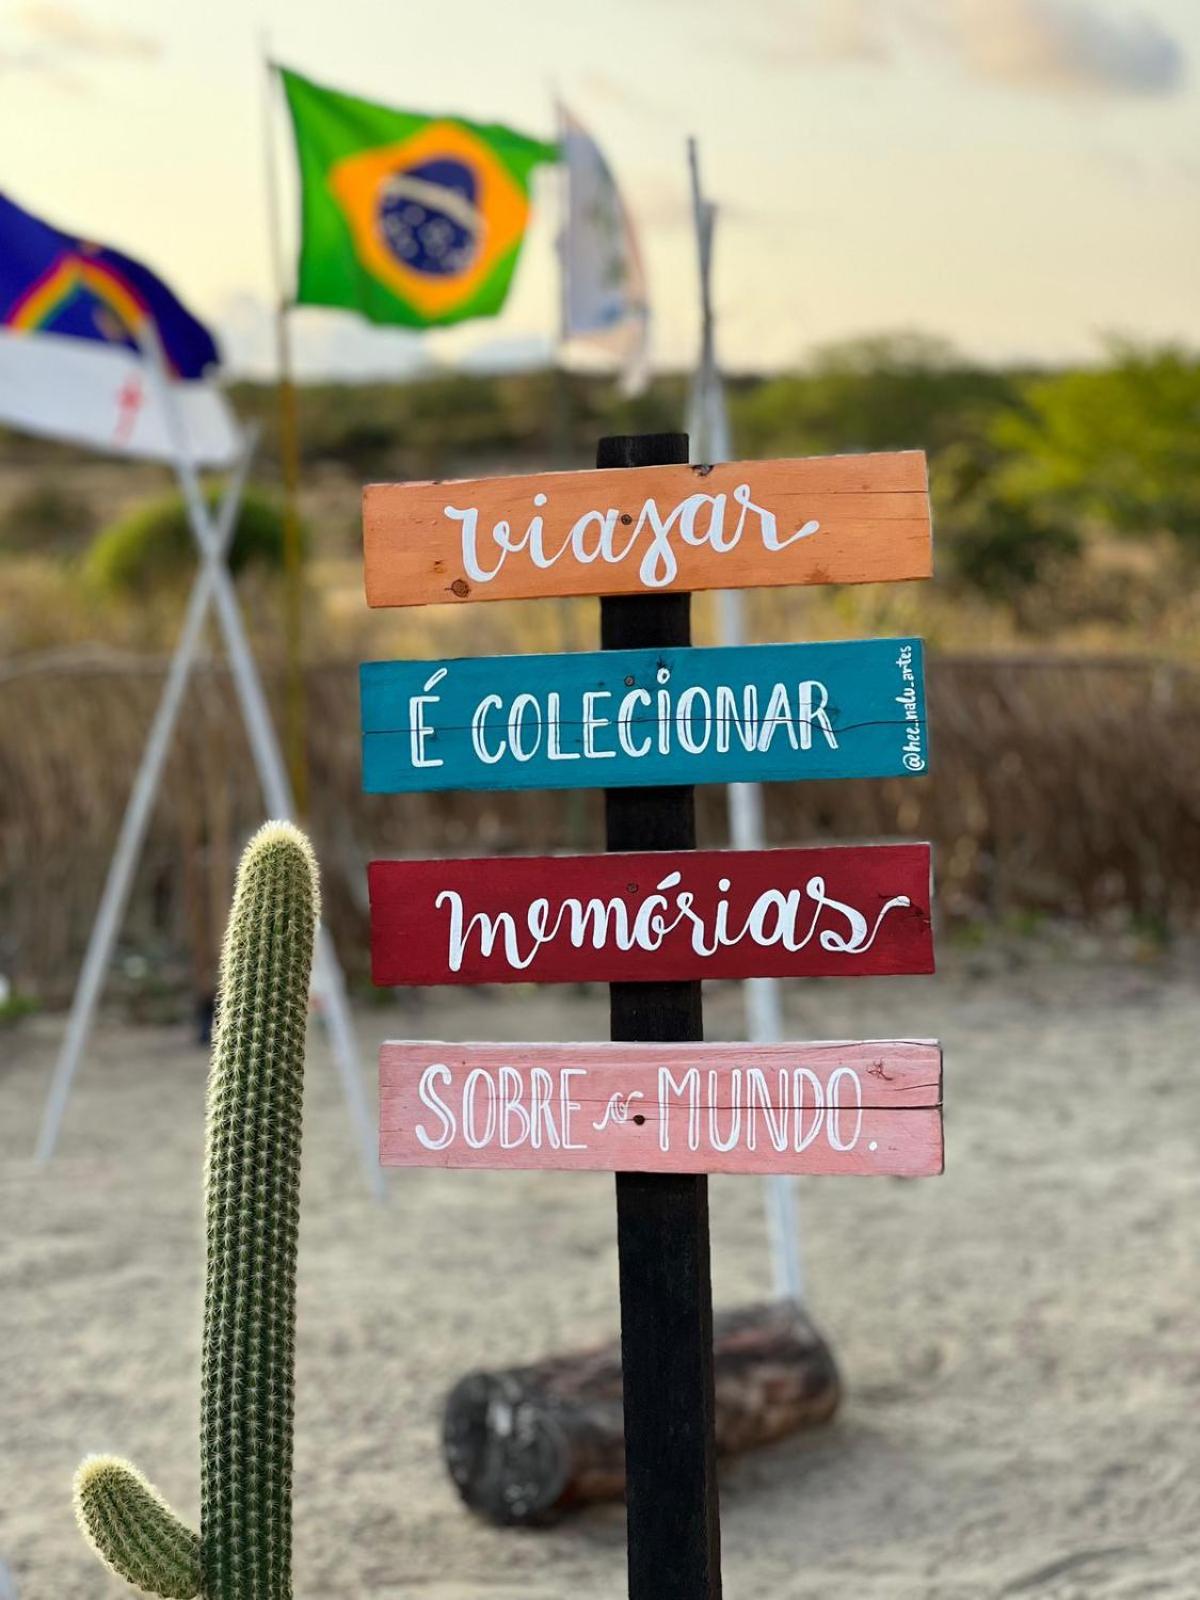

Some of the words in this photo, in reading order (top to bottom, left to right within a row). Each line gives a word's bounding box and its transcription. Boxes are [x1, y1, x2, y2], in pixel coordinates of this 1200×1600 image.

[408, 667, 449, 769] É
[415, 1063, 588, 1151] SOBRE
[658, 1066, 879, 1152] MUNDO.
